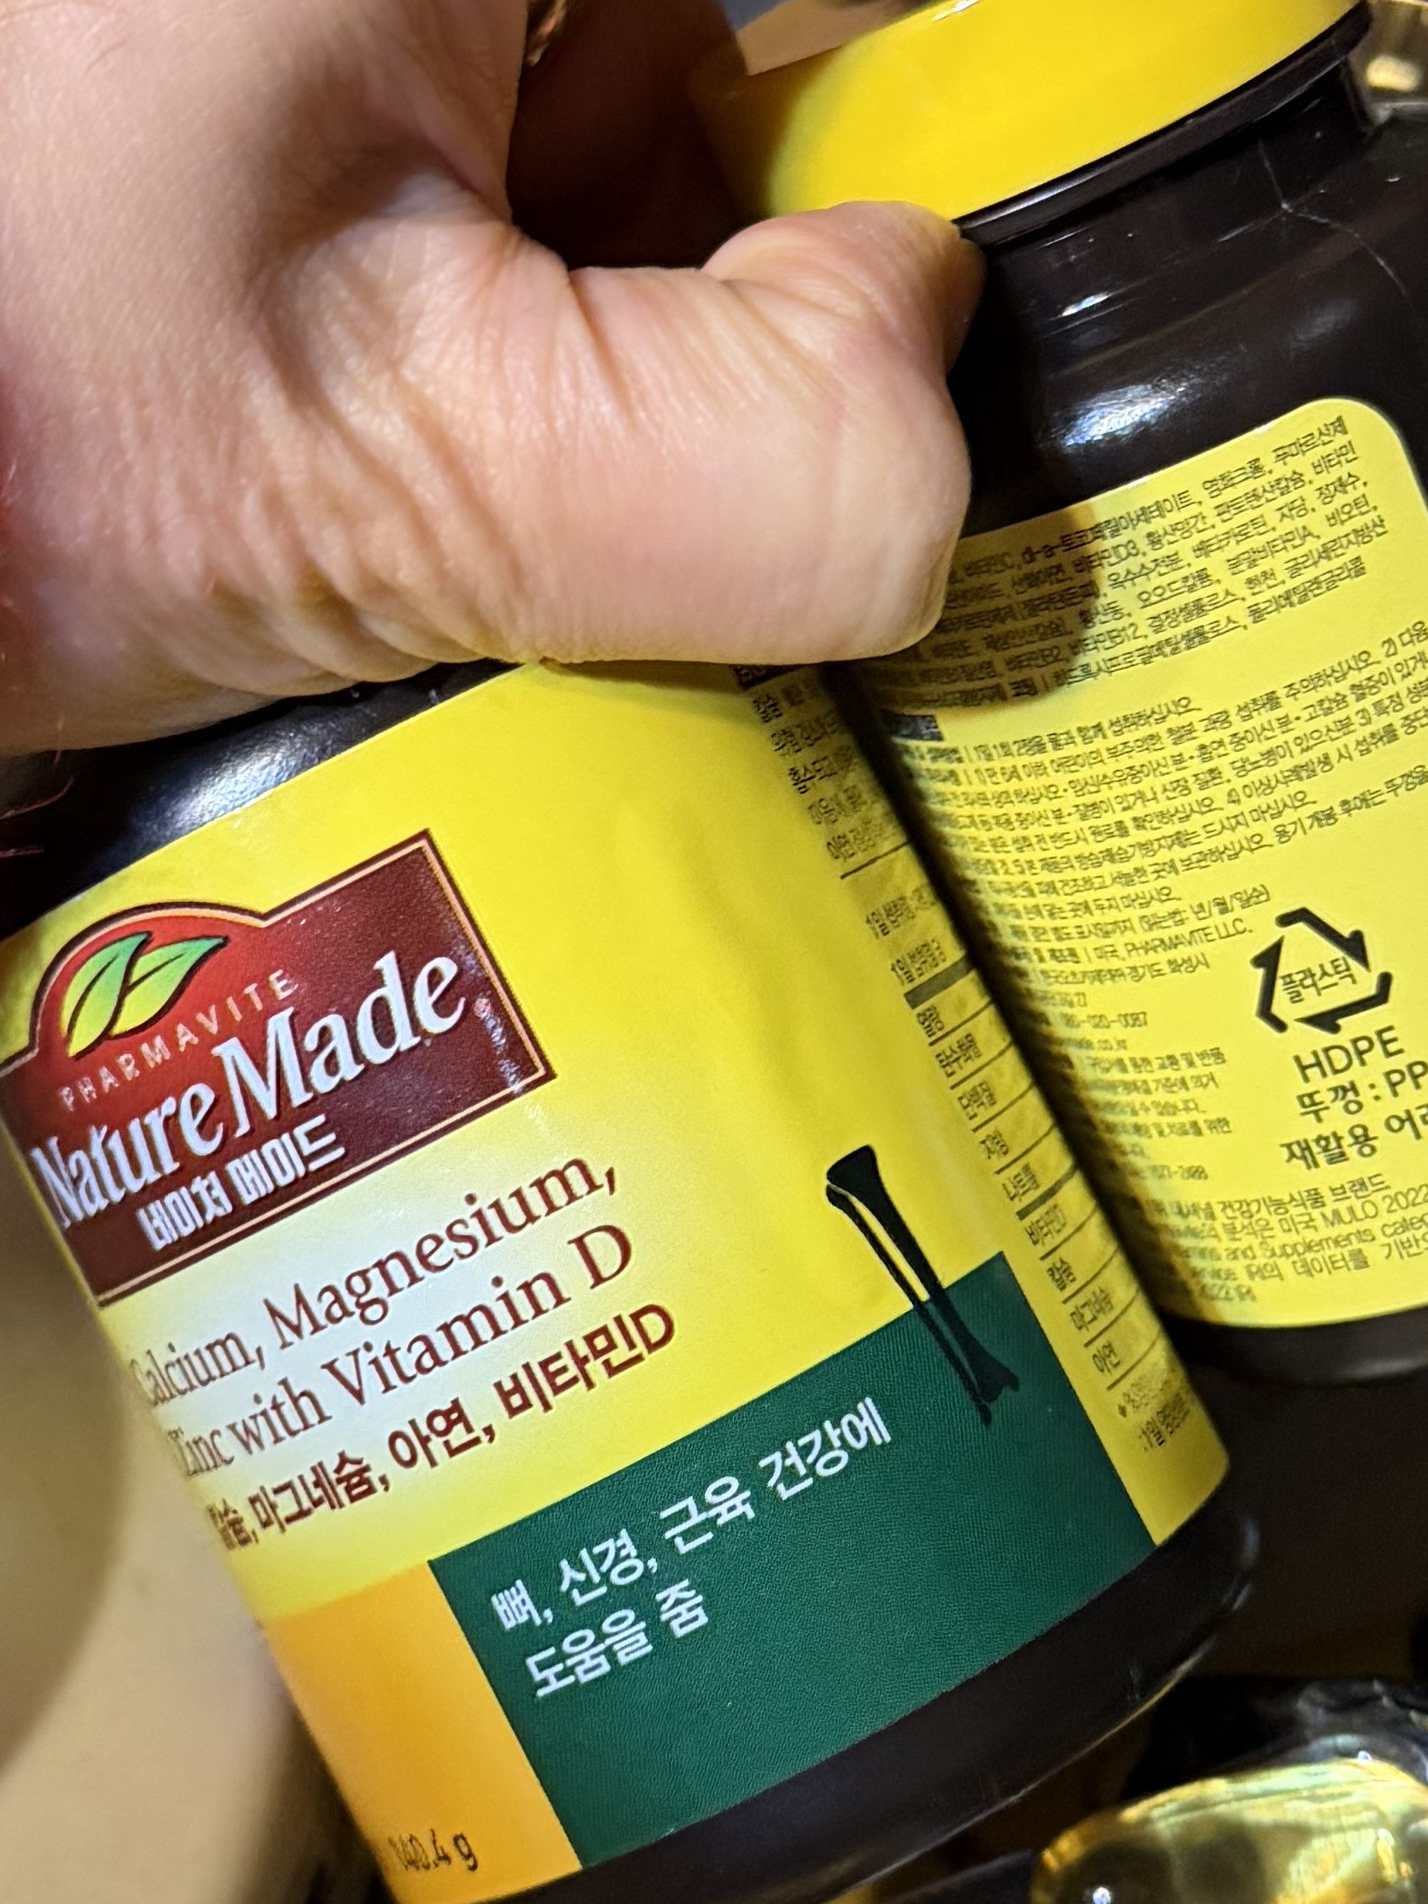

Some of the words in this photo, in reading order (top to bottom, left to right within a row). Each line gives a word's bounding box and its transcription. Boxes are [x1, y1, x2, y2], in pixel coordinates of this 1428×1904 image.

[1308, 440, 1359, 478] 비타민
[1313, 467, 1368, 506] 정제수,
[1333, 743, 1353, 764] 시
[1124, 924, 1216, 959] PHARMAVITE
[1279, 955, 1356, 1005] 플라스틱
[57, 967, 299, 1114] PHARMAVITE
[914, 1002, 946, 1039] 열량
[934, 1032, 983, 1079] 탄수화물
[1292, 1024, 1405, 1084] HDPE
[27, 1080, 232, 1229] Nature
[209, 950, 480, 1136] Made
[1295, 1079, 1365, 1127] 뚜껑
[1278, 1119, 1382, 1177] 재활용
[136, 1168, 234, 1252] 네이처
[224, 1111, 347, 1207] 메이드
[1000, 1162, 1041, 1204] 나트륨
[1217, 1185, 1326, 1225] 건강기능식품
[1327, 1170, 1392, 1205] 브랜드
[1277, 1208, 1319, 1240] 미국
[1320, 1196, 1380, 1230] MULO
[1259, 1225, 1375, 1263] Supplements
[125, 1316, 270, 1413] Calcium,
[260, 1146, 623, 1351] Magnesium,
[1042, 1254, 1079, 1294] 칼슘
[1068, 1284, 1114, 1334] 마그네슘
[218, 1369, 328, 1459] with
[320, 1252, 573, 1413] Vitamin
[567, 1216, 642, 1291] D
[1087, 1338, 1124, 1379] 아연
[247, 1440, 393, 1536] 마그네슘,
[380, 1388, 499, 1480] 아연,
[490, 1296, 682, 1427] 비타민D
[488, 1575, 555, 1635] 뼈,
[552, 1525, 661, 1611] 신경,
[653, 1471, 760, 1558] 근육
[755, 1395, 894, 1503] 건강에
[520, 1604, 658, 1701] 도움을
[651, 1577, 713, 1641] 줌
[451, 1830, 479, 1875] g
